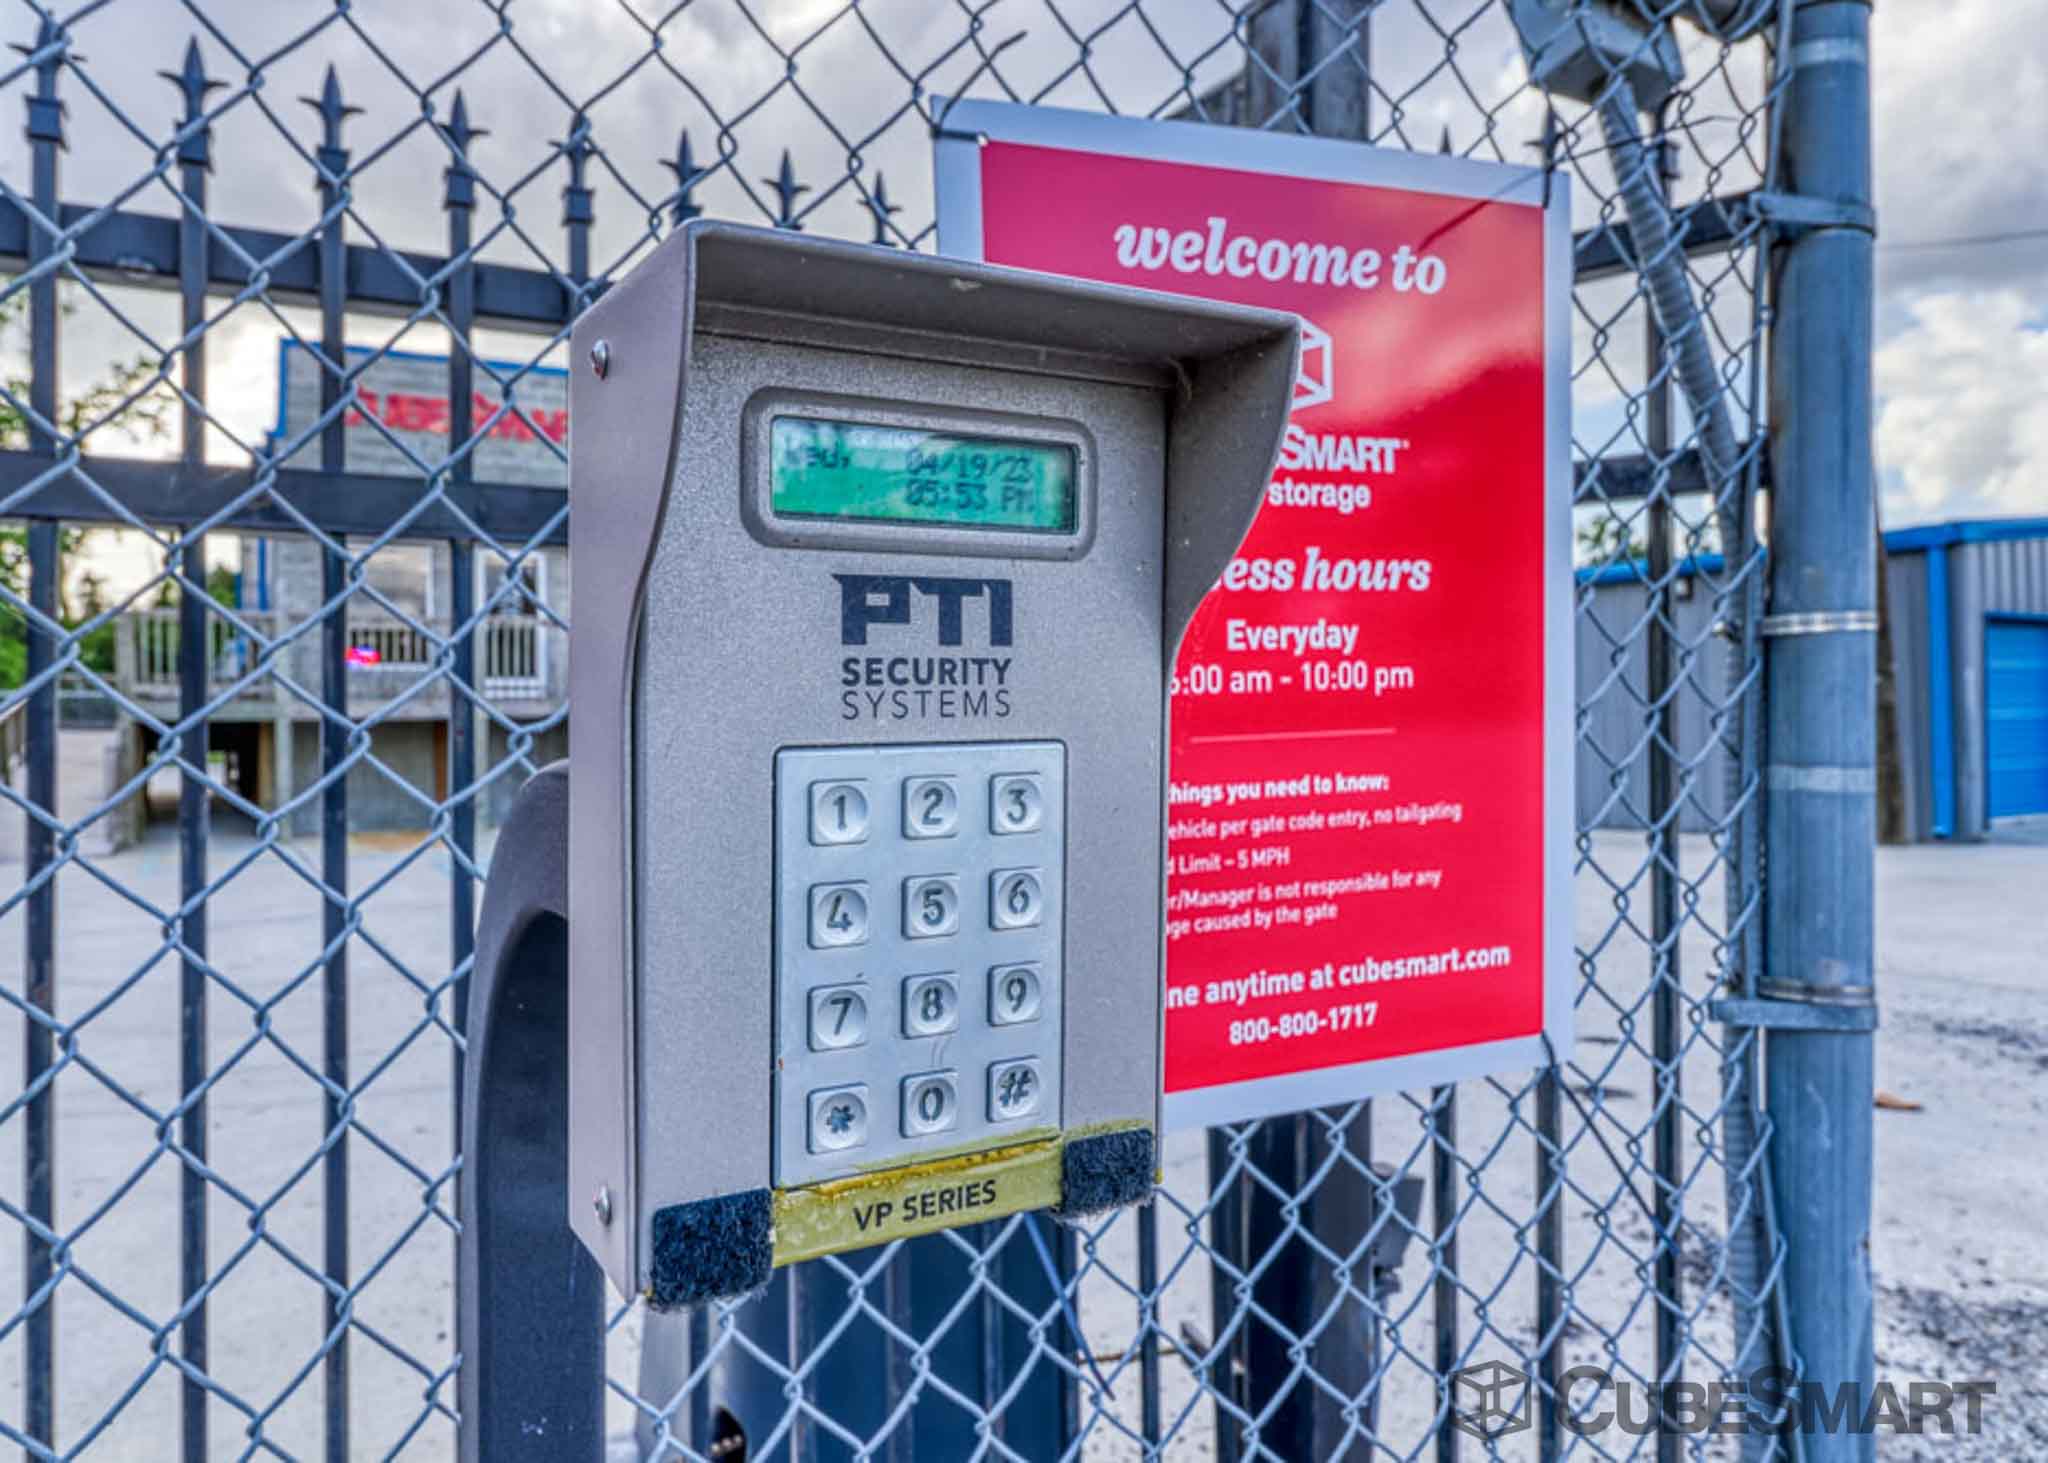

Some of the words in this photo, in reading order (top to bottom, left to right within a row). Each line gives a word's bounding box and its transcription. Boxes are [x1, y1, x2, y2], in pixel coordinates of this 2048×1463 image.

[1114, 217, 1380, 289] welcome
[1392, 244, 1446, 294] to
[1276, 424, 1402, 474] SMART
[1268, 476, 1372, 515] storage
[1211, 558, 1296, 591] ess
[1301, 546, 1431, 591] hours
[831, 574, 1013, 646] PTI
[1226, 618, 1358, 655] Everyday
[841, 657, 1012, 687] SECURITY
[1230, 670, 1272, 694] am
[1302, 661, 1367, 692] 10:00
[1374, 664, 1414, 696] pm
[841, 689, 1011, 720] SYSTEMS
[832, 794, 848, 831] 1
[921, 787, 944, 826] 2
[1006, 788, 1028, 824] 3
[1167, 782, 1224, 807] hings
[1226, 782, 1260, 806] you
[1264, 774, 1310, 798] need
[1313, 775, 1332, 795] to
[1334, 772, 1389, 794] know:
[1167, 817, 1216, 840] ehicle
[1220, 820, 1248, 840] per
[1250, 815, 1285, 839] gate
[1289, 811, 1324, 832] code
[1327, 809, 1372, 830] entry,
[1373, 809, 1393, 824] no
[1395, 801, 1462, 826] tailgating
[1179, 853, 1221, 875] Limit
[1237, 848, 1249, 870] 5
[1251, 846, 1290, 868] MPH
[826, 893, 853, 932] 4
[921, 888, 945, 926] 5
[1008, 879, 1030, 914] 6
[1166, 887, 1254, 912] r/Manager
[1257, 882, 1272, 901] is
[1275, 881, 1300, 900] not
[1303, 872, 1389, 899] responsible
[1391, 869, 1413, 888] for
[1415, 870, 1442, 889] any
[1193, 908, 1250, 934] caused
[1254, 907, 1272, 930] by
[1275, 906, 1300, 924] the
[1303, 903, 1339, 926] gate
[1205, 969, 1305, 1006] anytime
[1309, 962, 1335, 990] at
[1338, 945, 1510, 987] cubesmart.com
[829, 997, 853, 1036] 7
[921, 986, 944, 1022] 8
[1005, 976, 1027, 1013] 9
[1228, 1001, 1379, 1046] 800-800-1717
[919, 1086, 944, 1122] 0
[999, 1069, 1032, 1107] #
[853, 1202, 892, 1231] VP
[902, 1179, 997, 1222] SERIES
